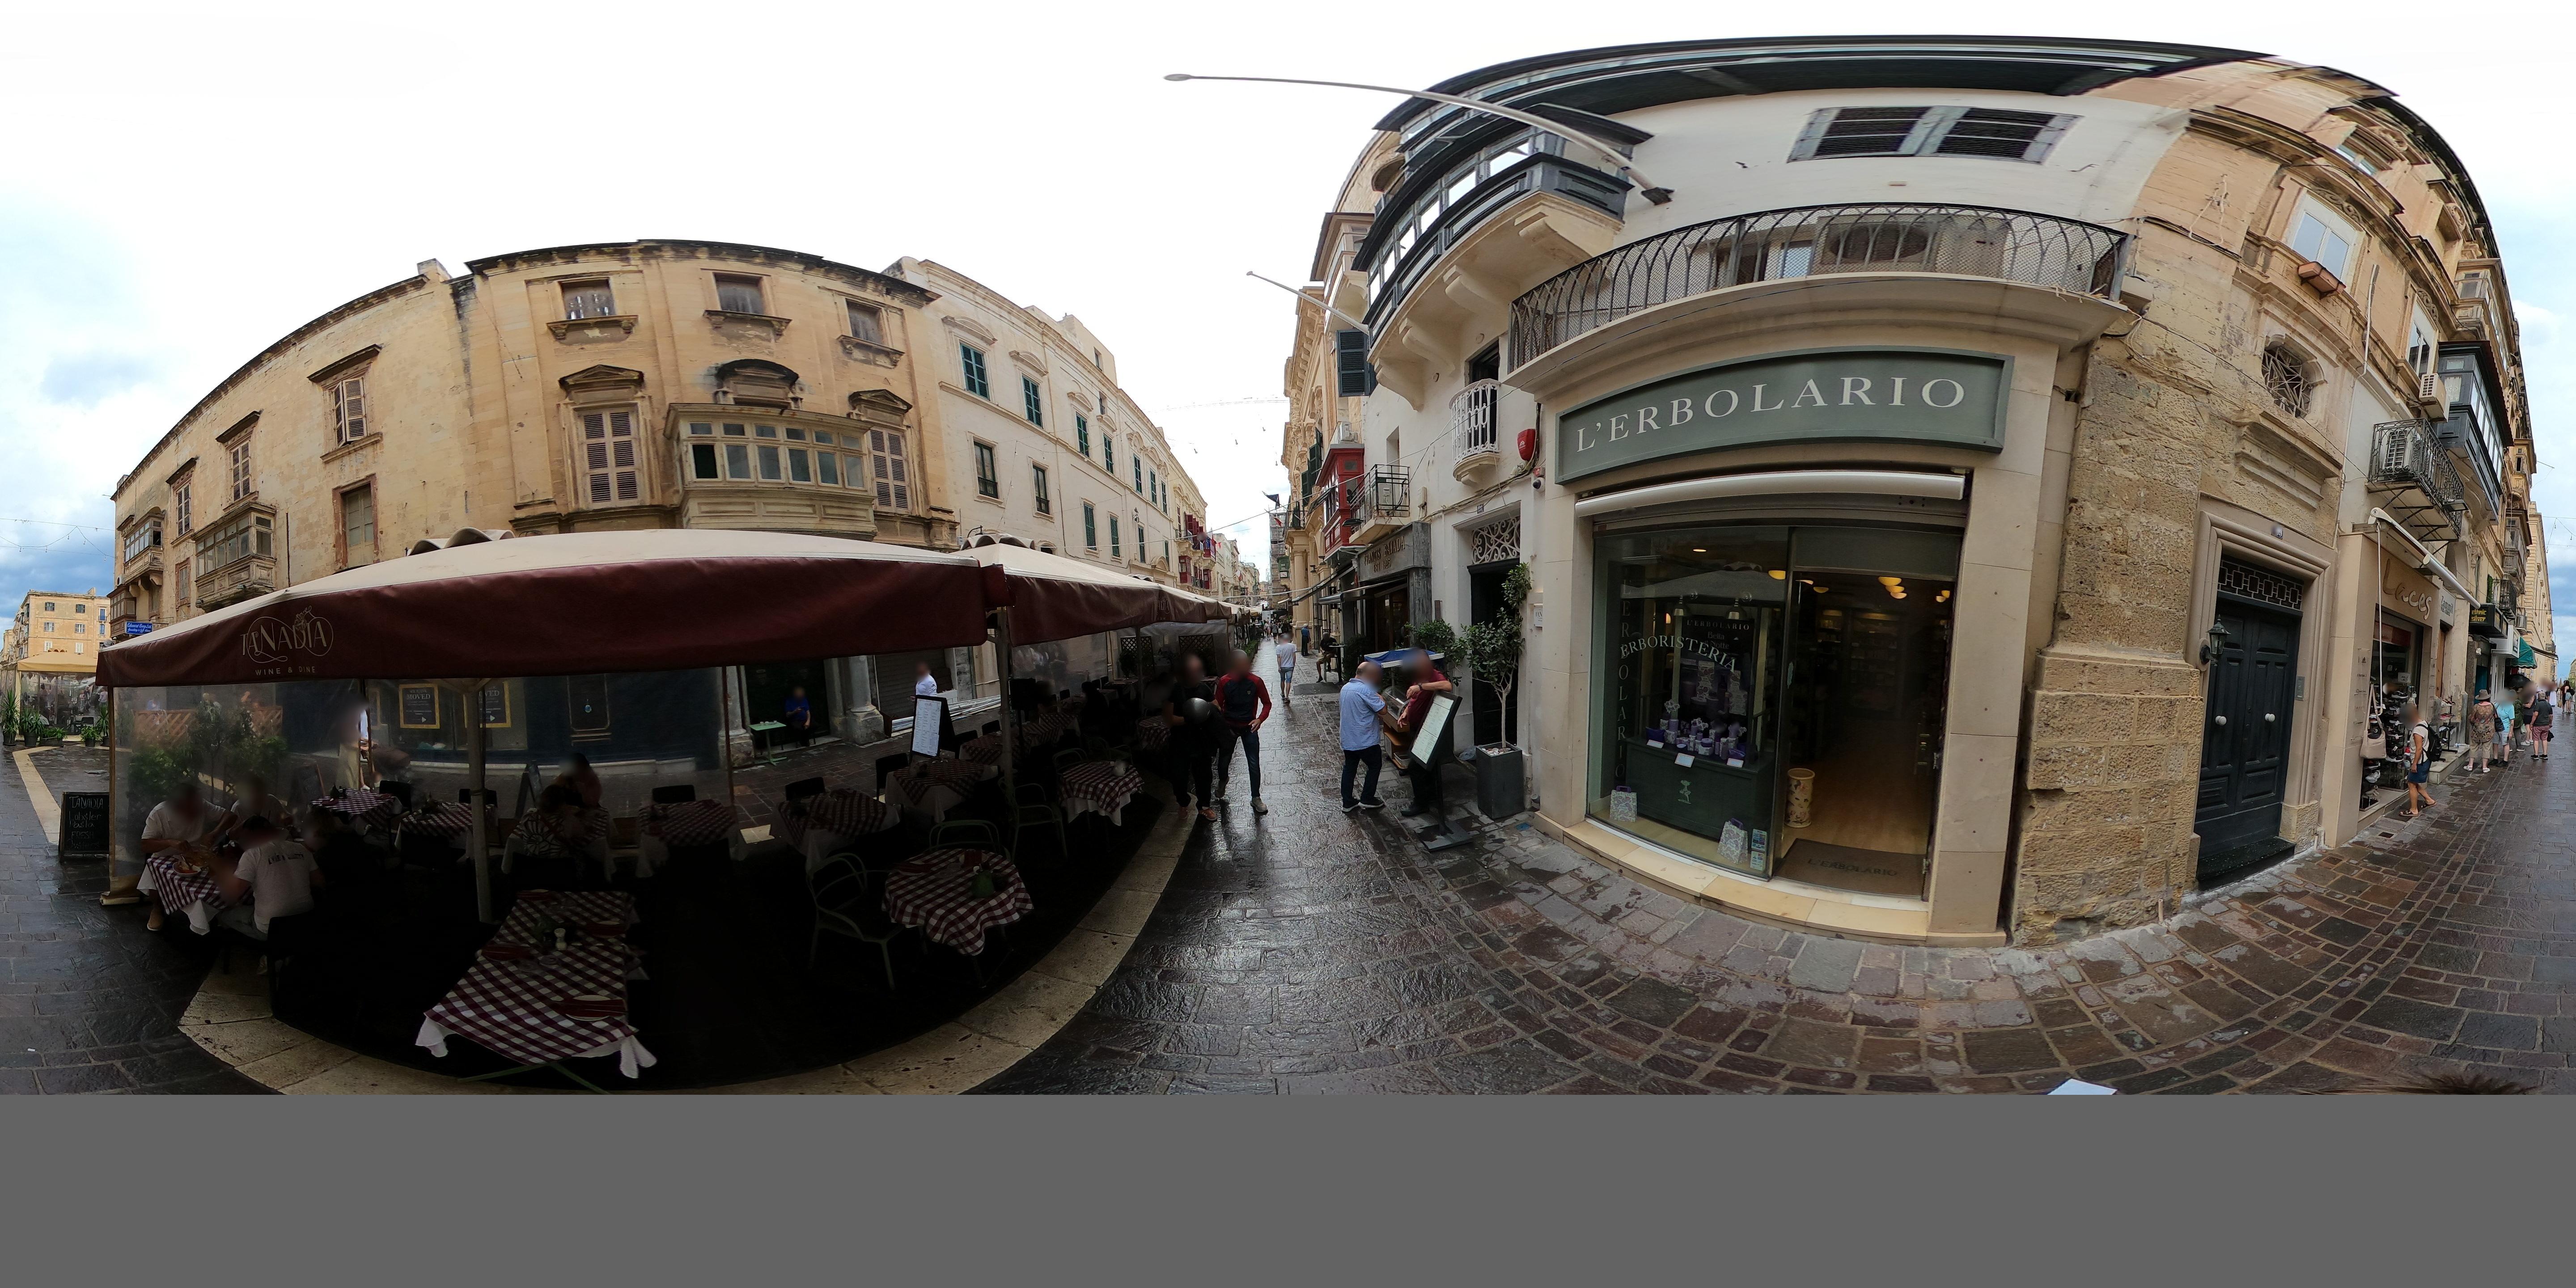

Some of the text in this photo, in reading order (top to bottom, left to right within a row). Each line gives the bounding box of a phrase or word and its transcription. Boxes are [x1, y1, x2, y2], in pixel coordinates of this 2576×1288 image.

[1576, 377, 1965, 453] L'ERBOLARIO
[1364, 548, 1381, 566] FRANCIS
[2382, 558, 2432, 620] Laces
[1687, 619, 1750, 630] L'ERBOLARIO
[240, 621, 327, 656] TANADIA
[1707, 631, 1724, 640] Bella
[1710, 640, 1730, 649] Notte
[1619, 635, 1737, 673] ERBORISTERIA
[255, 668, 281, 676] WINE
[69, 796, 103, 809] TANADIA
[69, 810, 101, 821] Lobster
[1807, 858, 1897, 876] L'ERBOLARIO
